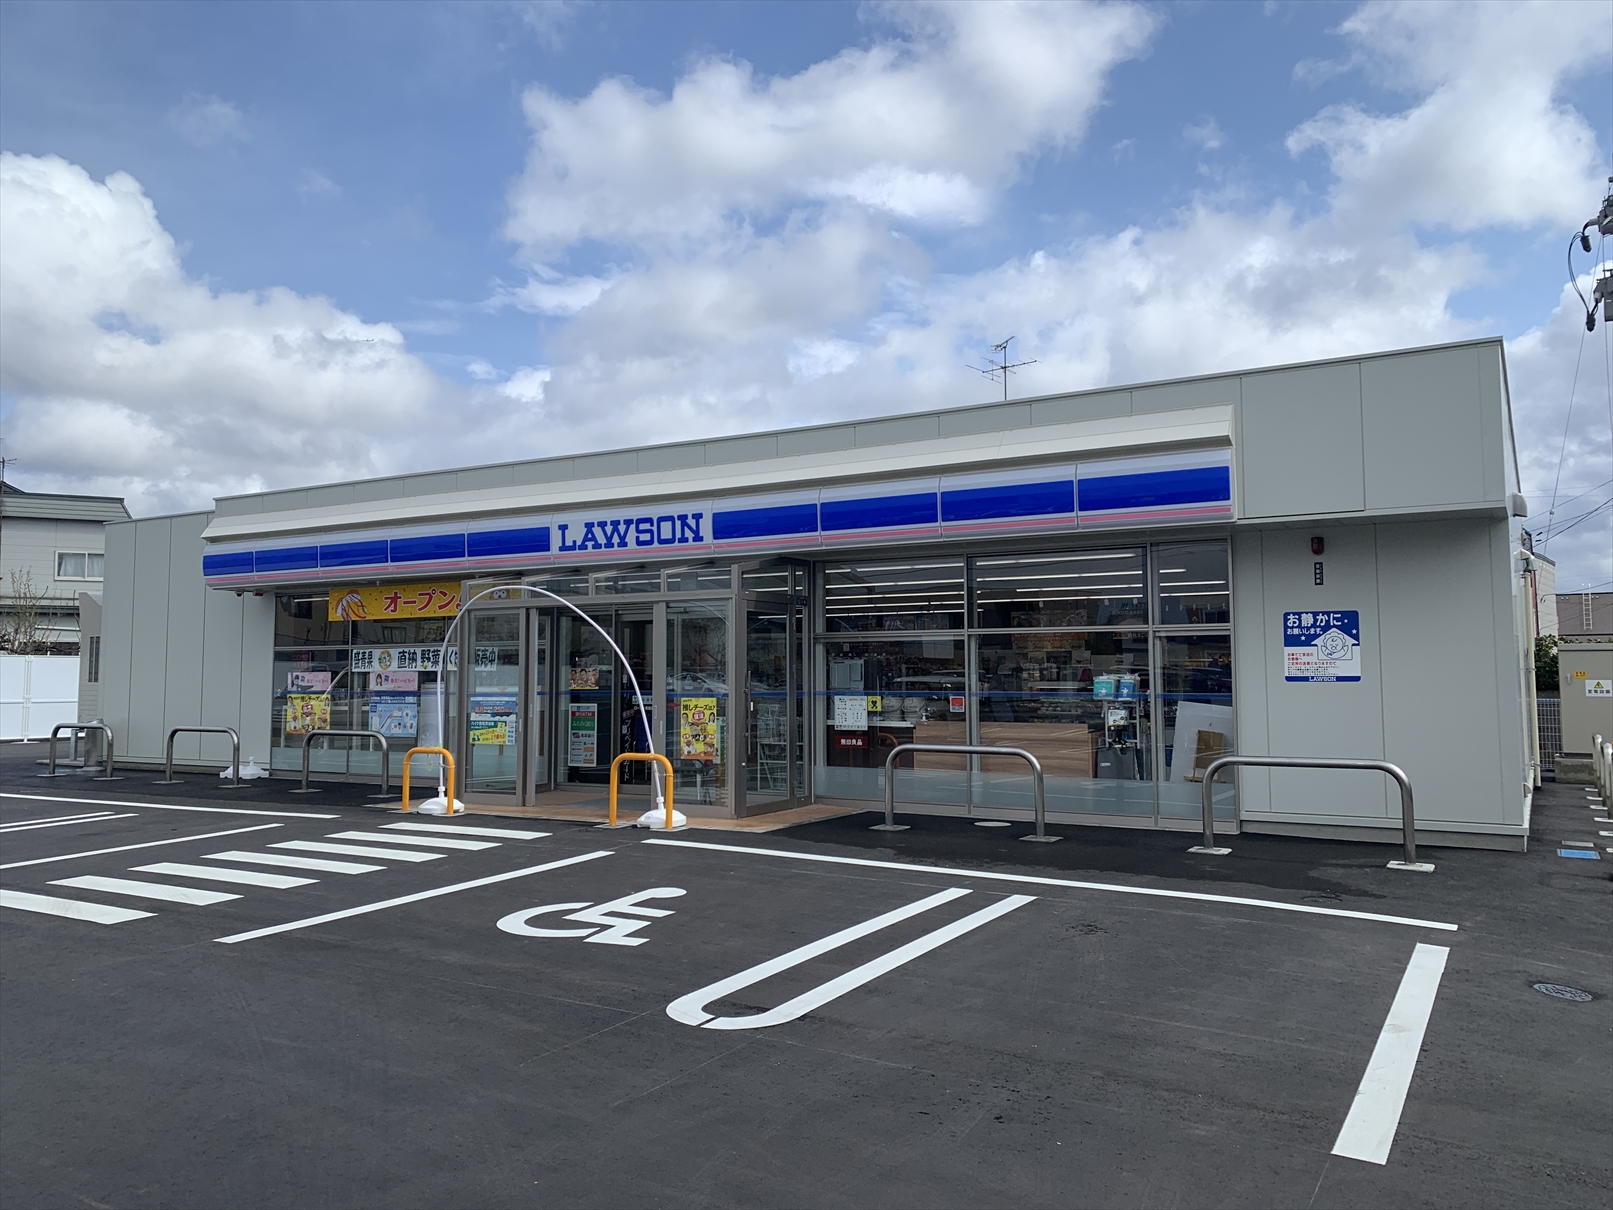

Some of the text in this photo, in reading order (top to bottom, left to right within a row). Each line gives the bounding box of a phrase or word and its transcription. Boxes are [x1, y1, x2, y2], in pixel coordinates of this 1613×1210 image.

[557, 512, 704, 552] LAWSON
[1287, 613, 1342, 627] お静かに
[1287, 627, 1323, 635] お願いします。
[397, 649, 418, 669] 直納
[420, 648, 441, 669] 野菜
[623, 719, 632, 782] プリペイカード
[840, 738, 863, 746] 無印良品
